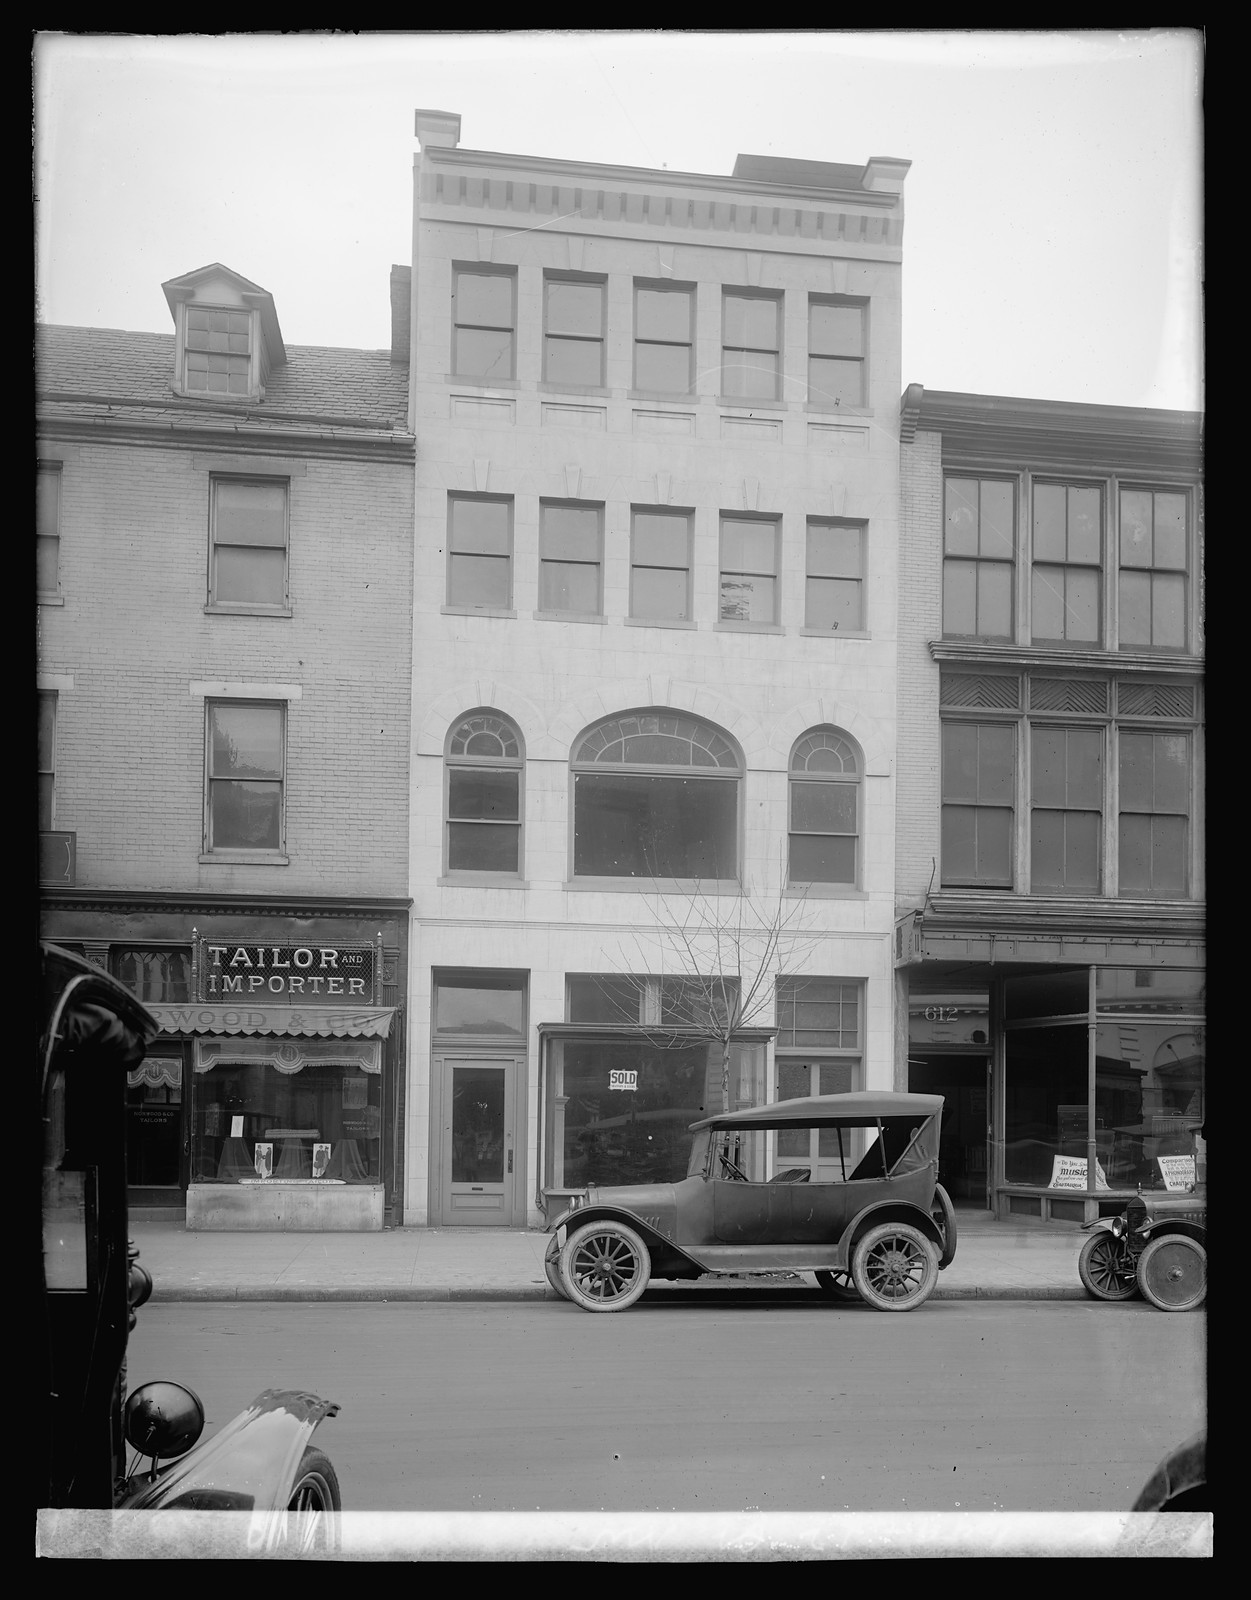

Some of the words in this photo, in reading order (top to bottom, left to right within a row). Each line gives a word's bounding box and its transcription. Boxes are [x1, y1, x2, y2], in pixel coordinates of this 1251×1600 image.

[208, 947, 339, 968] TAILOR
[341, 955, 363, 963] AND
[209, 975, 365, 995] IMPORTER
[288, 1014, 306, 1027] &
[925, 1006, 959, 1021] 612
[611, 1072, 636, 1084] SOLD
[1060, 1168, 1088, 1177] music
